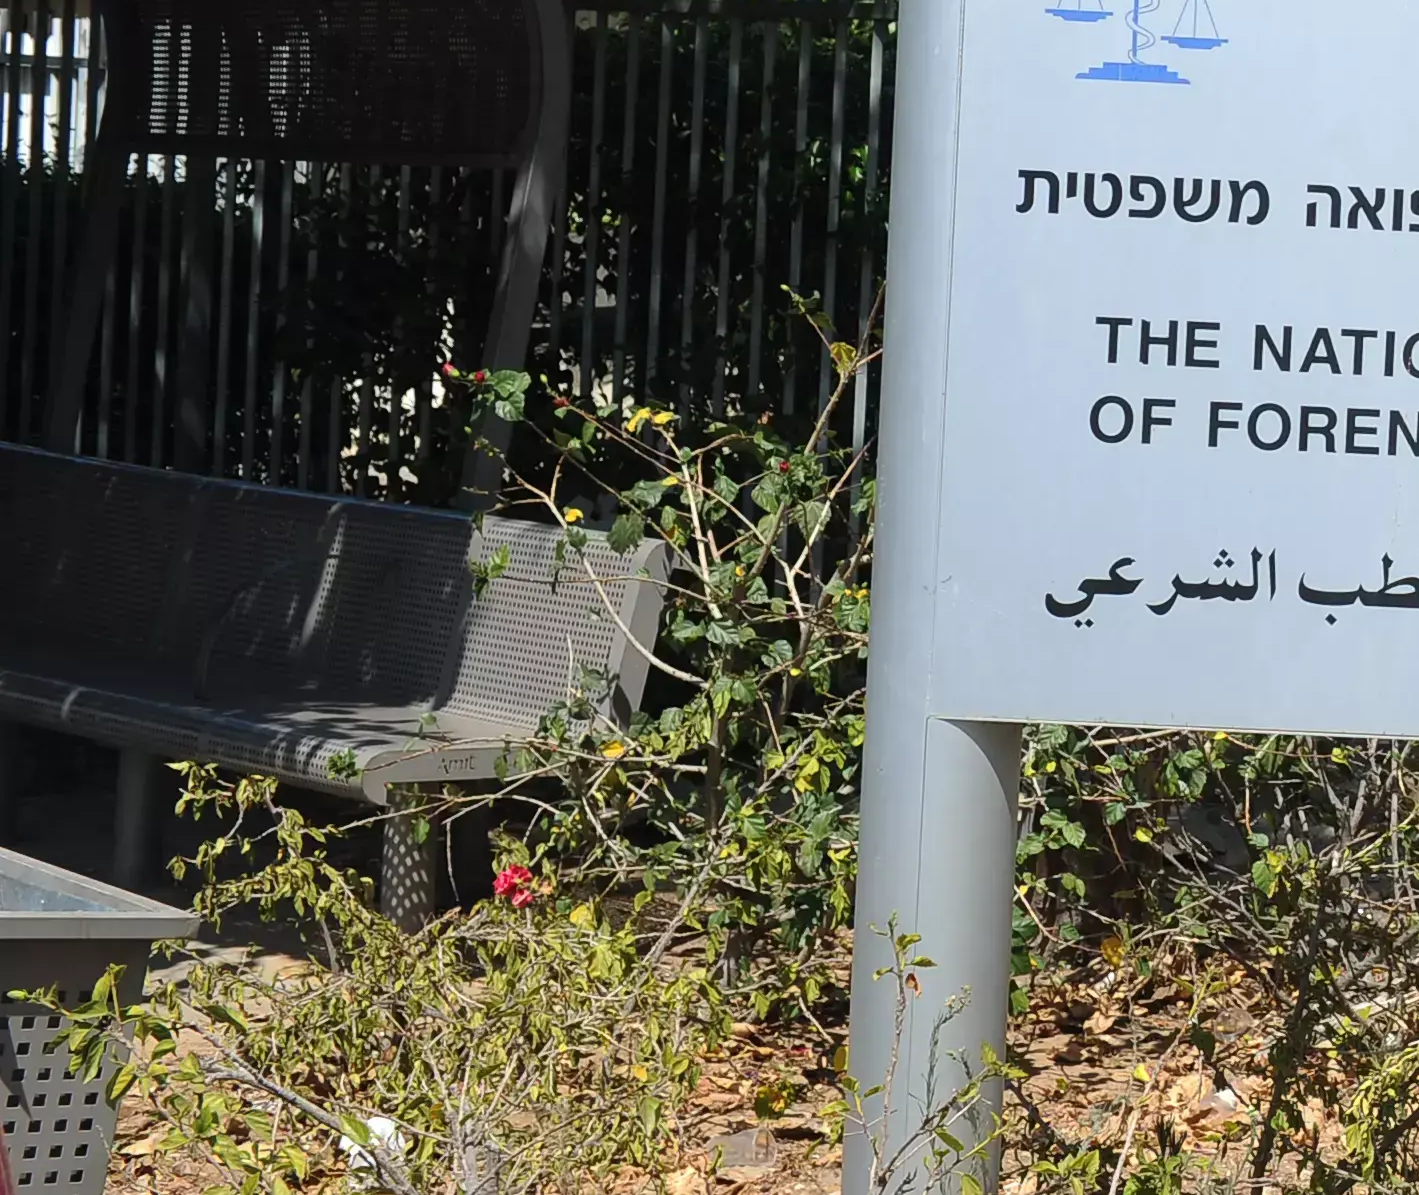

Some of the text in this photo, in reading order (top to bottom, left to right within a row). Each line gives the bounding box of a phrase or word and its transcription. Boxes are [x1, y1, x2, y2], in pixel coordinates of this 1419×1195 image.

[1015, 169, 1270, 226] משפטית
[1095, 316, 1220, 369] THE
[1089, 395, 1176, 444] OF
[1043, 546, 1277, 629] الشرعي
